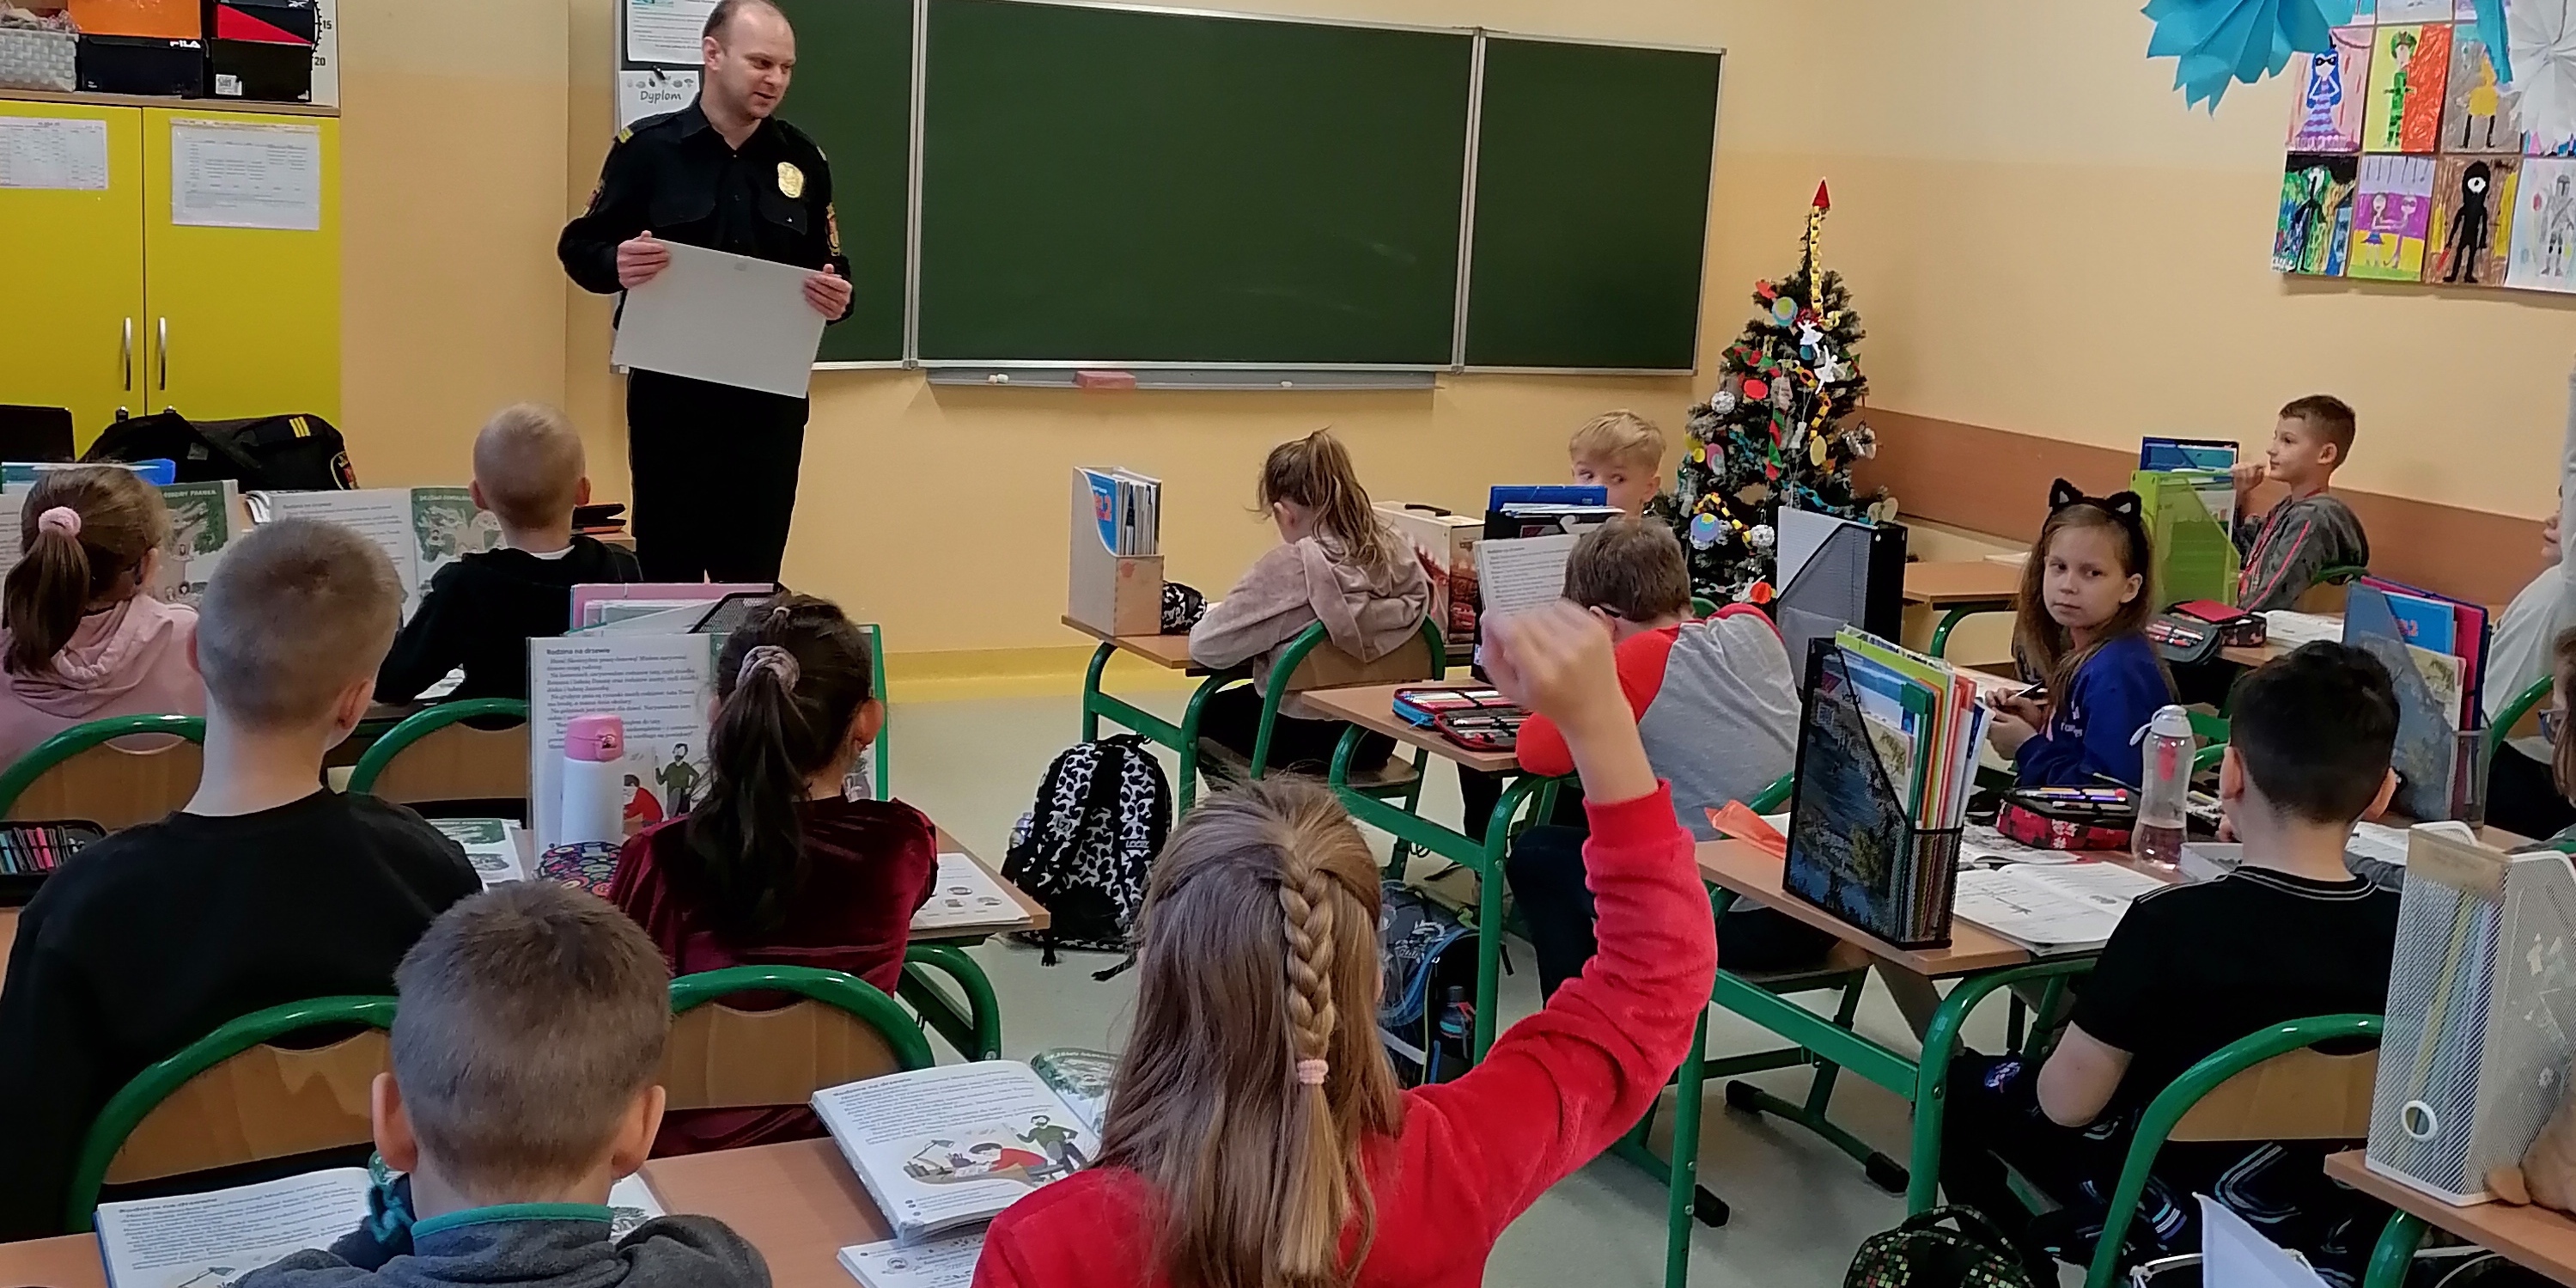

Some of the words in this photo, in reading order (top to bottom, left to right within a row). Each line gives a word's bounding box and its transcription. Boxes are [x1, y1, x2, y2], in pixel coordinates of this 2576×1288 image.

[323, 20, 332, 30] 15
[169, 40, 201, 48] FILA
[314, 57, 326, 66] 20
[640, 89, 682, 104] Dyplom
